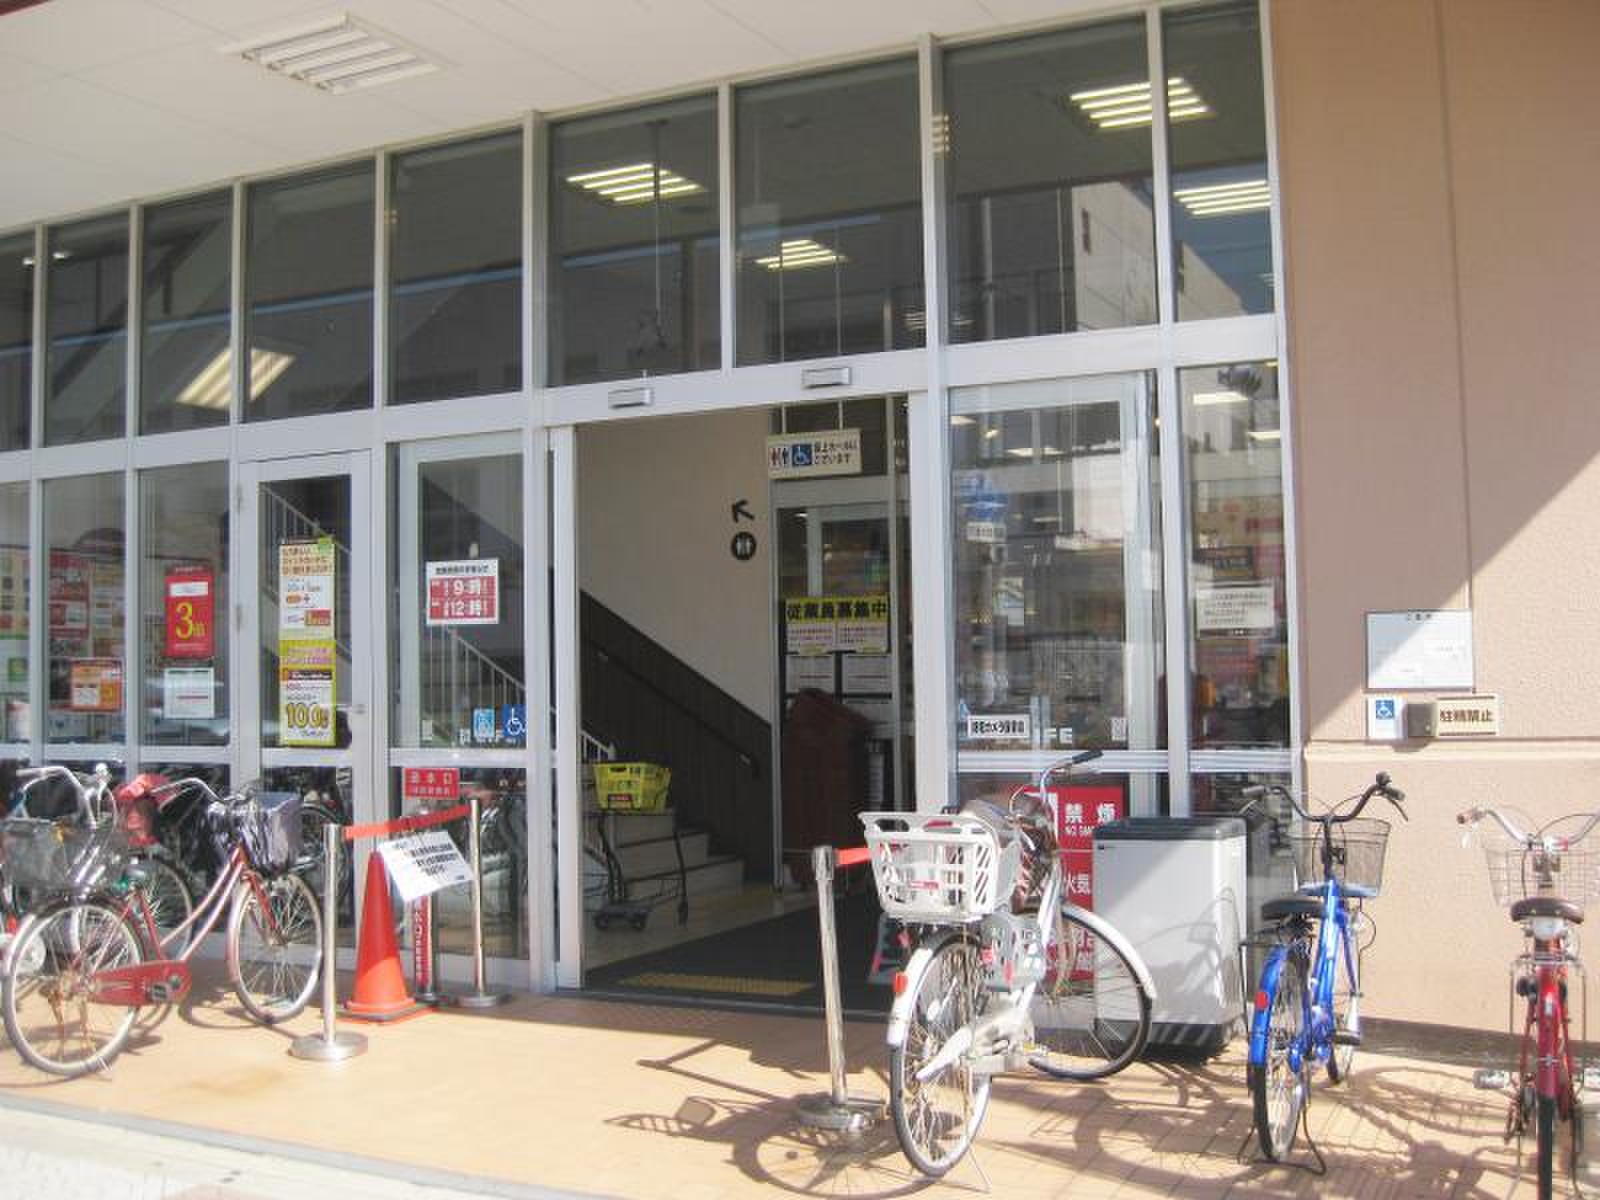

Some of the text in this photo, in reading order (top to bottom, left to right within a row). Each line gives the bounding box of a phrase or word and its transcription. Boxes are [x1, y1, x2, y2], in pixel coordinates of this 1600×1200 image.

[786, 600, 888, 620] 従業員募集中
